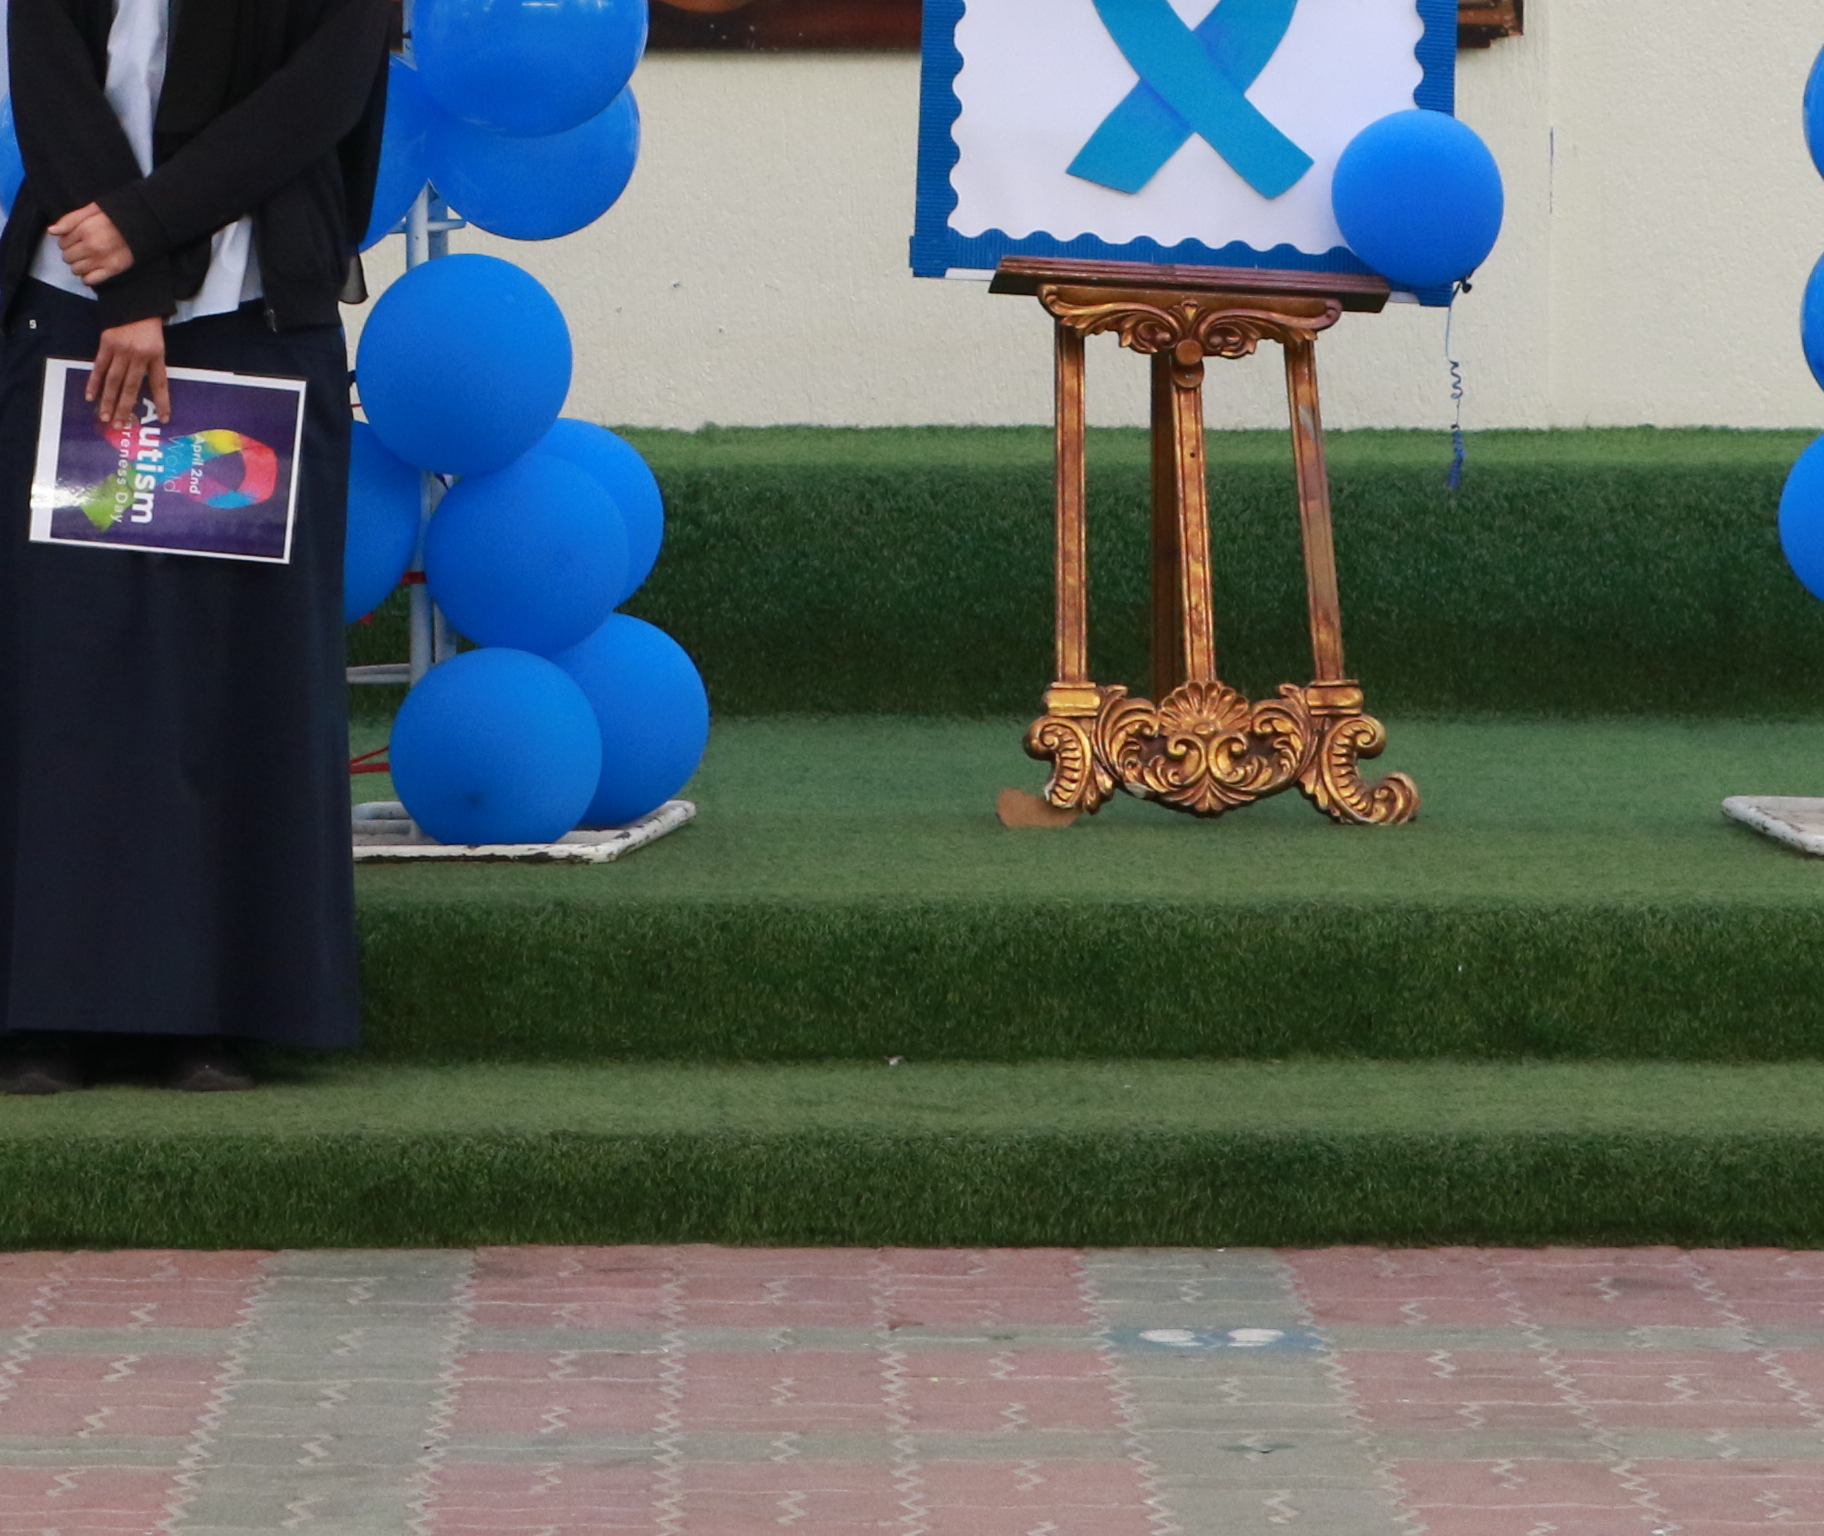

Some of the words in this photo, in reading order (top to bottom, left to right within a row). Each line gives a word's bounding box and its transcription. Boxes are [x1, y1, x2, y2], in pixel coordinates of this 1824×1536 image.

[130, 397, 165, 524] Autism
[163, 434, 186, 494] World
[190, 433, 206, 467] April
[188, 468, 203, 495] 2nd
[110, 491, 128, 523] Day
